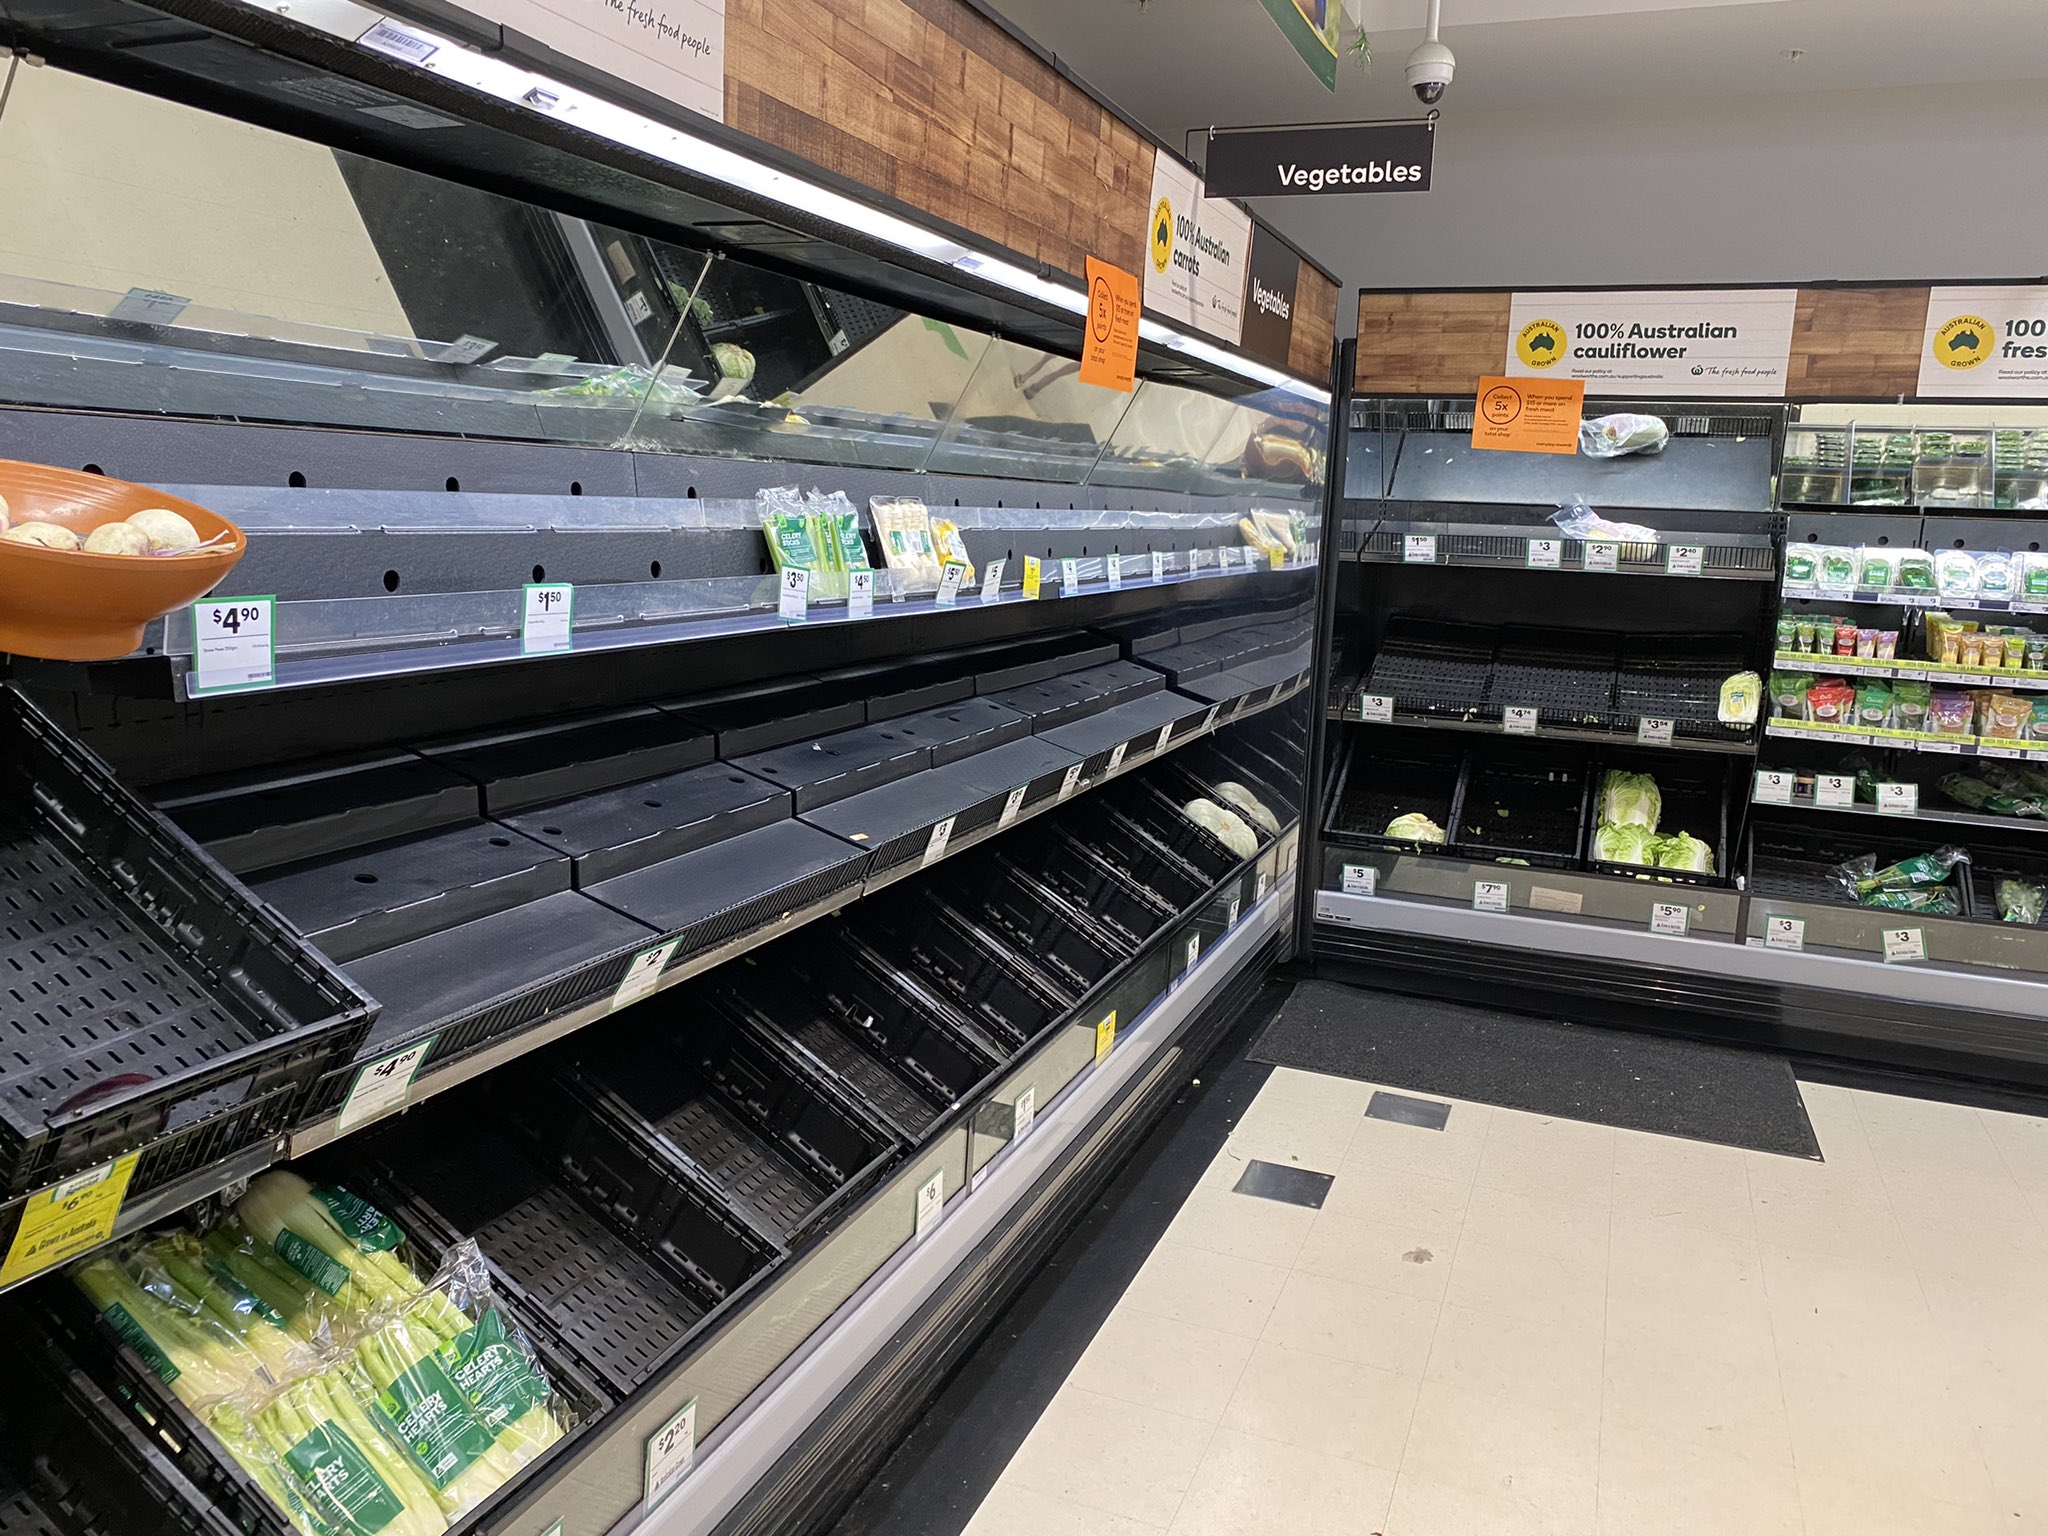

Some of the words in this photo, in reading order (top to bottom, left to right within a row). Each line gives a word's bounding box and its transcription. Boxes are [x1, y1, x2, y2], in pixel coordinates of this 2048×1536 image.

[627, 0, 655, 29] fresh
[657, 14, 682, 39] food
[681, 33, 711, 58] people
[1277, 160, 1422, 191] Vegetables
[1176, 214, 1196, 245] 100%
[1195, 227, 1230, 266] Australian
[1173, 249, 1200, 276] carrots
[1253, 277, 1289, 320] Vegetables
[1522, 321, 1560, 338] AUSTRALIAN
[1575, 323, 1624, 339] 100%
[1628, 322, 1737, 339] Australian
[1941, 317, 1986, 336] AUSTRALIAN
[1573, 342, 1687, 359] cauliflower
[1531, 356, 1557, 367] GROWN
[1950, 355, 1981, 367] GROWN
[1721, 368, 1740, 378] fresh
[1755, 368, 1777, 378] people
[1495, 401, 1508, 411] 5x
[1539, 542, 1551, 551] $3
[213, 607, 259, 634] $490
[1371, 697, 1383, 707] $3
[1768, 774, 1781, 785] $3
[1829, 778, 1842, 788] $3
[1890, 786, 1904, 796] $3
[1353, 868, 1364, 878] $5
[1660, 906, 1682, 916] $590
[1779, 920, 1792, 931] $3
[1895, 931, 1910, 942] $3
[646, 949, 663, 966] $2
[374, 1051, 416, 1077] $490
[927, 1183, 936, 1200] $6
[38, 1235, 60, 1251] Grown
[67, 1219, 98, 1238] Australia
[455, 1346, 499, 1380] CELERY
[460, 1356, 503, 1390] HEARTS
[398, 1389, 442, 1434] CELERY
[403, 1400, 448, 1444] HEARTS
[658, 1417, 686, 1455] $220
